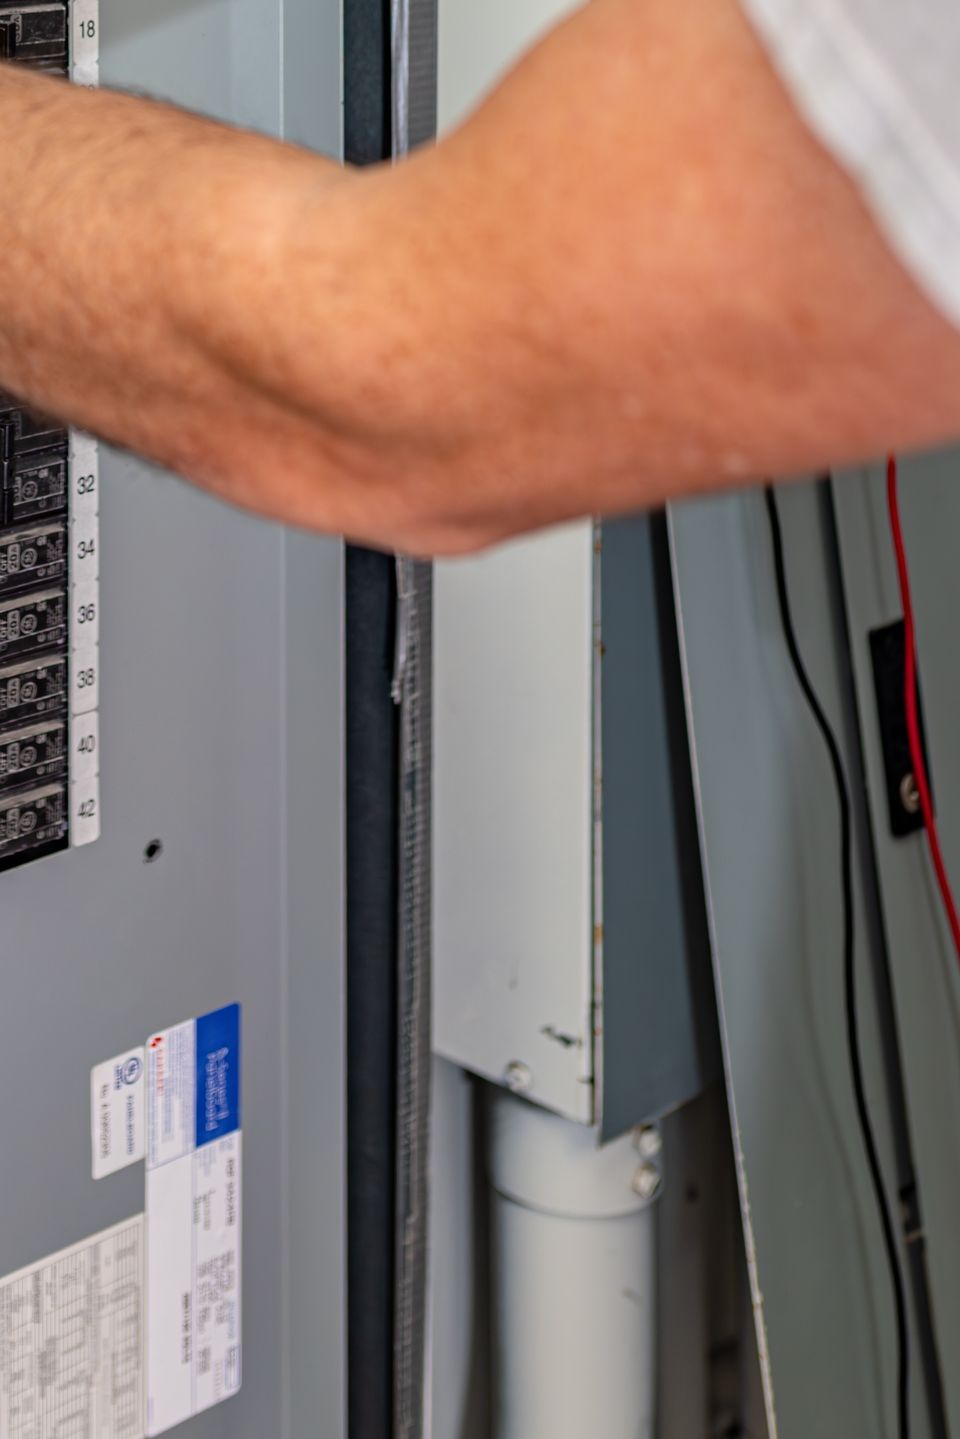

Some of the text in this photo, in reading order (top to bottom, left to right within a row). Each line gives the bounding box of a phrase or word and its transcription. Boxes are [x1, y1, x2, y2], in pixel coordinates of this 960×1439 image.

[79, 19, 95, 38] 18
[77, 474, 95, 495] 32
[78, 539, 95, 560] 34
[78, 603, 95, 624] 36
[77, 668, 94, 689] 38
[77, 734, 94, 753] 40
[77, 798, 95, 818] 42
